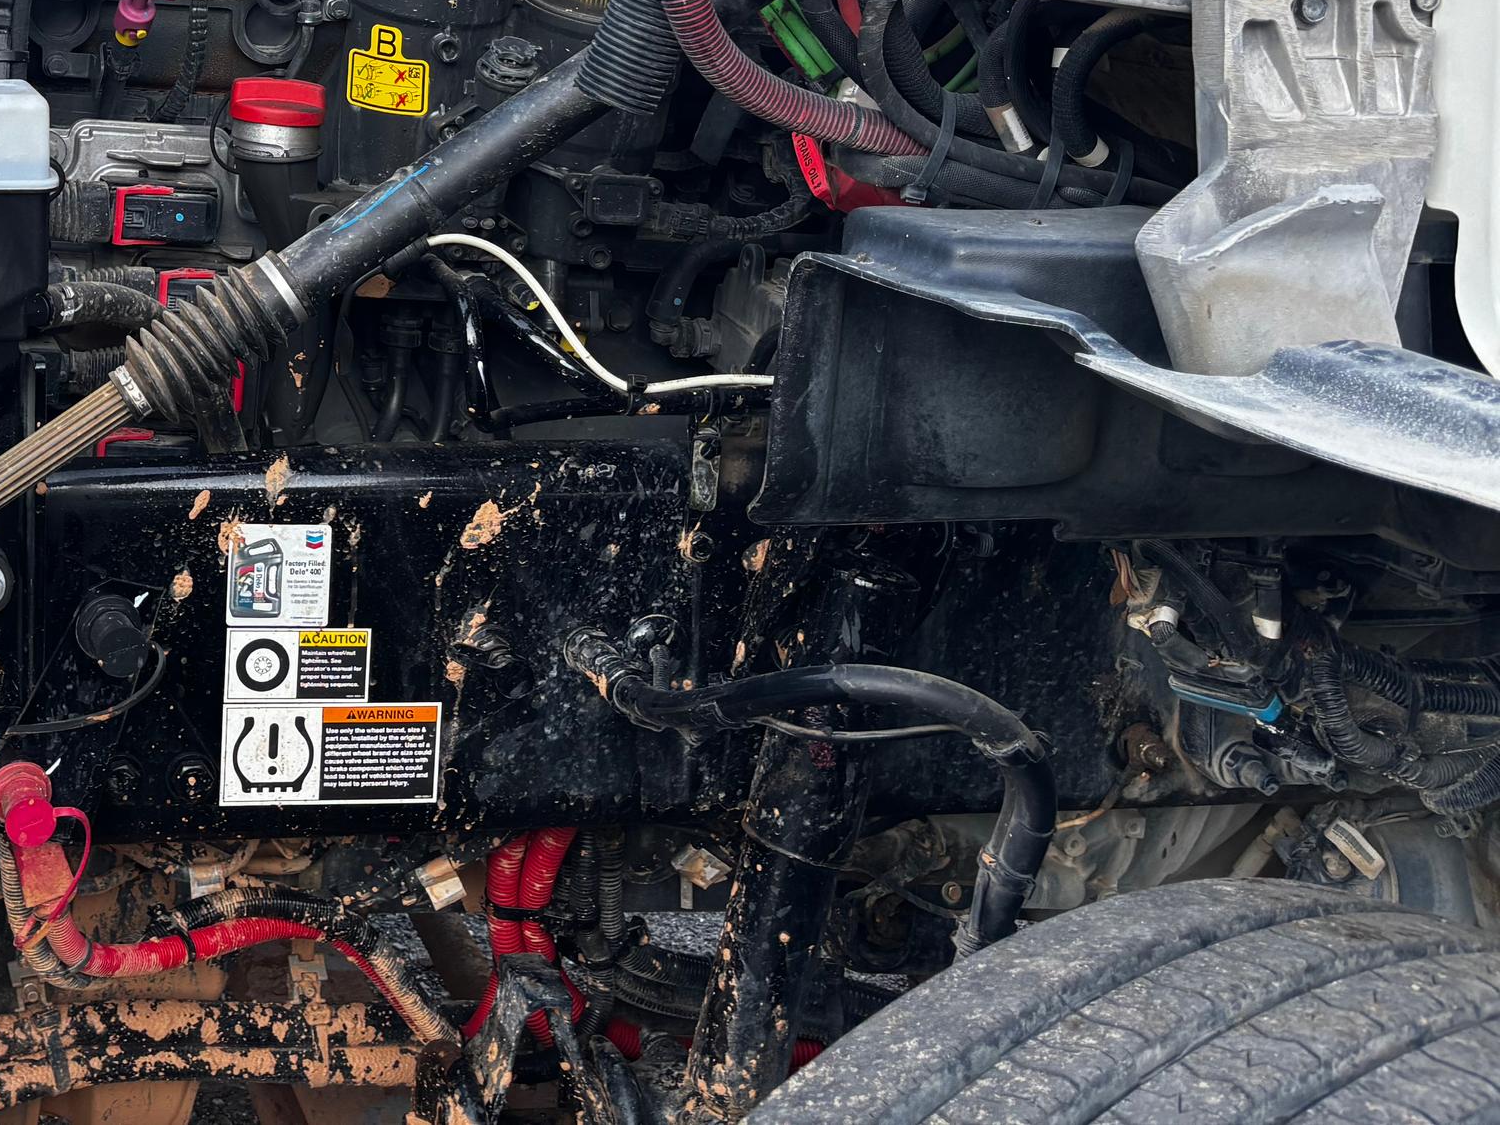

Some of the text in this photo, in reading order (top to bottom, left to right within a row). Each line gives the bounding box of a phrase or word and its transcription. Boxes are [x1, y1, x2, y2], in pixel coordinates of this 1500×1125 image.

[377, 28, 396, 57] B
[797, 136, 818, 184] TRANS OIL
[312, 635, 366, 643] CAUTION
[357, 710, 414, 719] WARNING
